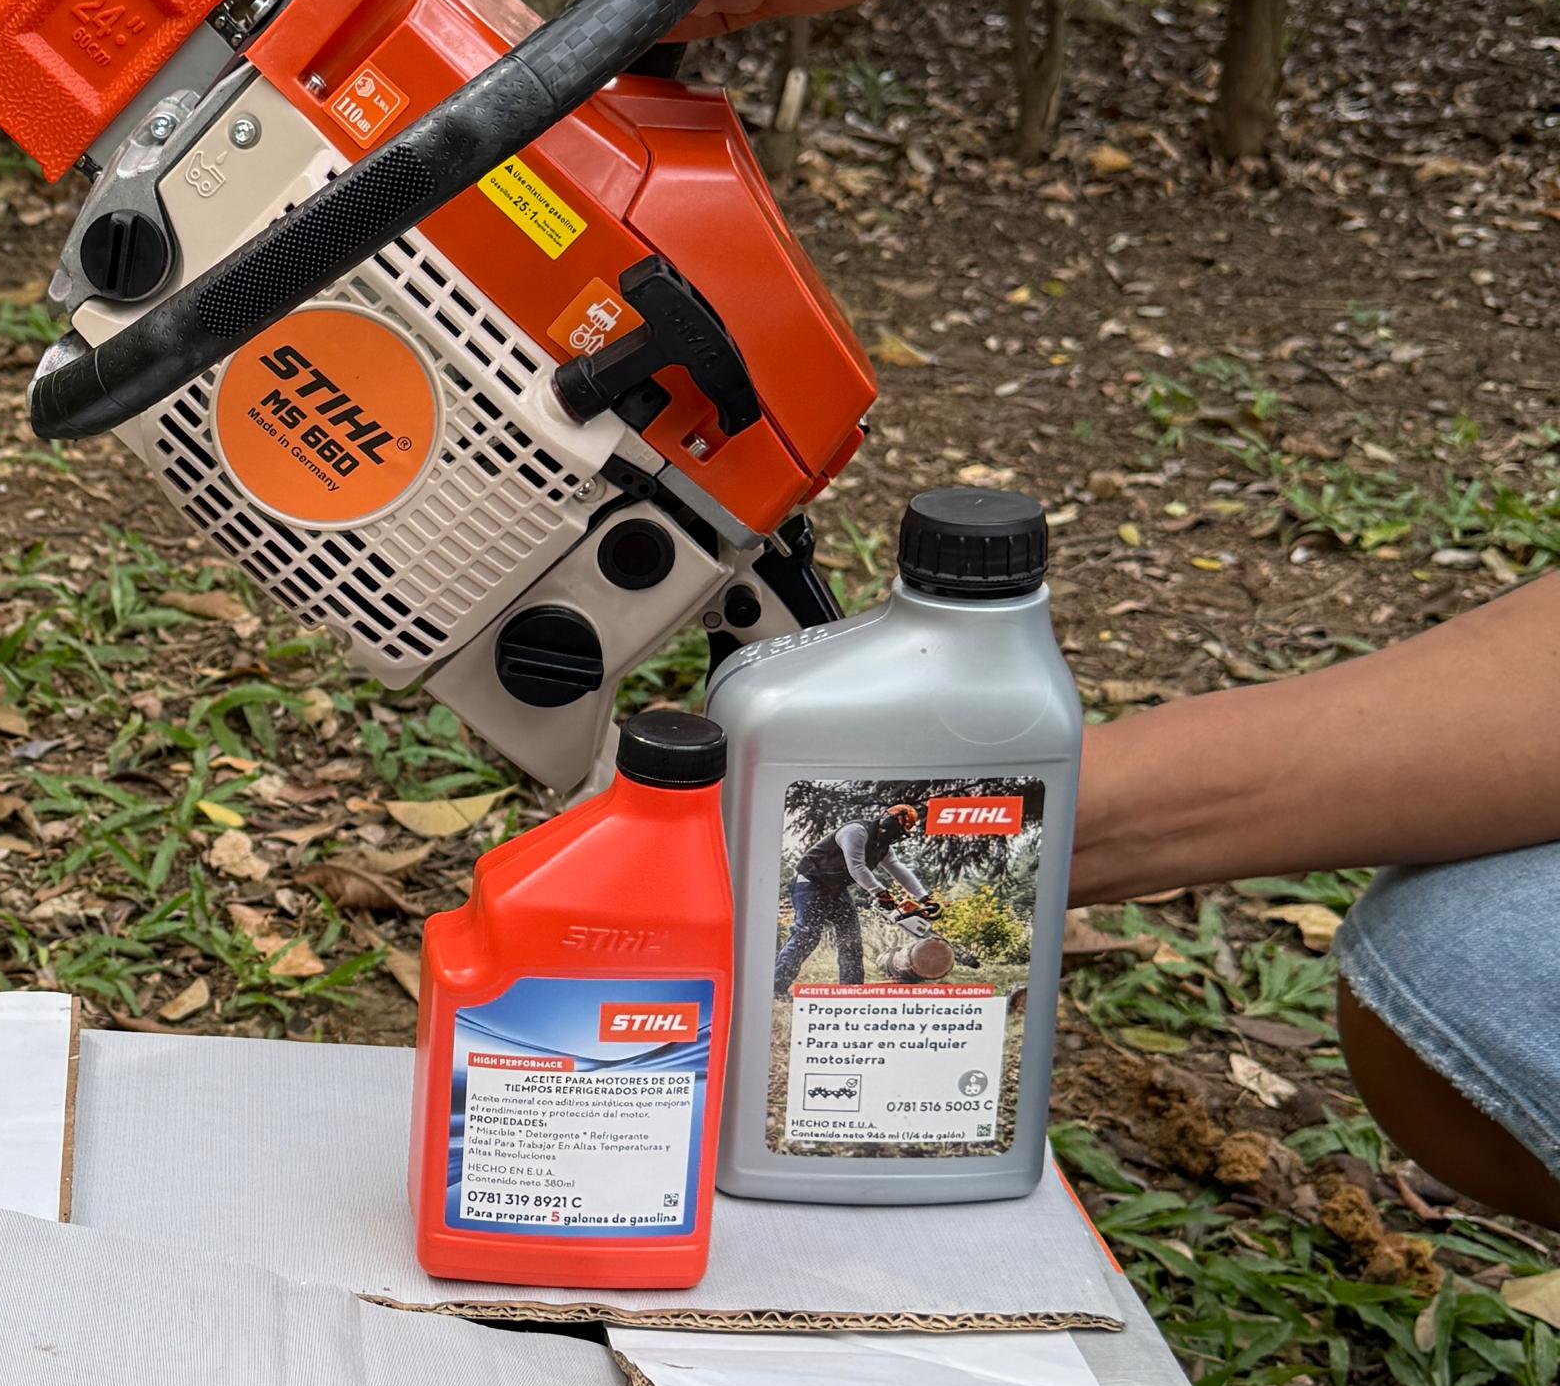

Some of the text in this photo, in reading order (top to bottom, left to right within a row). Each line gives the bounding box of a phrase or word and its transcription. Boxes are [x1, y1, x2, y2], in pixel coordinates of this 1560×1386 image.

[72, 27, 111, 66] 60cm
[513, 171, 526, 185] Use
[526, 184, 550, 208] mixture
[513, 196, 538, 221] 25:1
[258, 345, 394, 465] STIHL
[260, 389, 359, 477] MS 660
[248, 407, 277, 437] Made
[291, 446, 340, 492] Germany
[936, 807, 1012, 824] STIHL
[562, 925, 661, 952] STIHL
[799, 987, 991, 995] ACEITE LUBRICANTE PARA ESPADA Y CADENA
[809, 1003, 982, 1017] Proporciona lubricación
[610, 1014, 688, 1031] STIHL
[808, 1020, 982, 1034] para tu cadena y espada
[807, 1037, 967, 1051] Para usar en cualquier
[473, 1056, 562, 1069] HIGH PERFORMACE
[806, 1054, 885, 1065] motosierra
[524, 1076, 690, 1085] ACEITE PARA MOTORES DE DOS
[505, 1084, 689, 1095] TIEMPOS REFRIGERADOS POR AIRE
[471, 1093, 499, 1103] Aceite
[502, 1095, 534, 1105] mineral
[636, 1101, 653, 1109] que
[886, 1100, 993, 1112] 0781 516 5003 C
[791, 1119, 829, 1128] HECHO
[832, 1120, 846, 1128] EN
[525, 1129, 579, 1140] Detergente
[590, 1131, 649, 1141] Refrigerante
[791, 1129, 840, 1139] Contenido
[494, 1139, 515, 1148] Para
[558, 1142, 570, 1150] En
[468, 1163, 506, 1174] HECHO
[510, 1166, 524, 1175] EN
[467, 1174, 517, 1185] Contenido
[468, 1190, 582, 1208] 0781 319 8921 C
[467, 1206, 677, 1225] Para preparar 5 galones de gasolina
